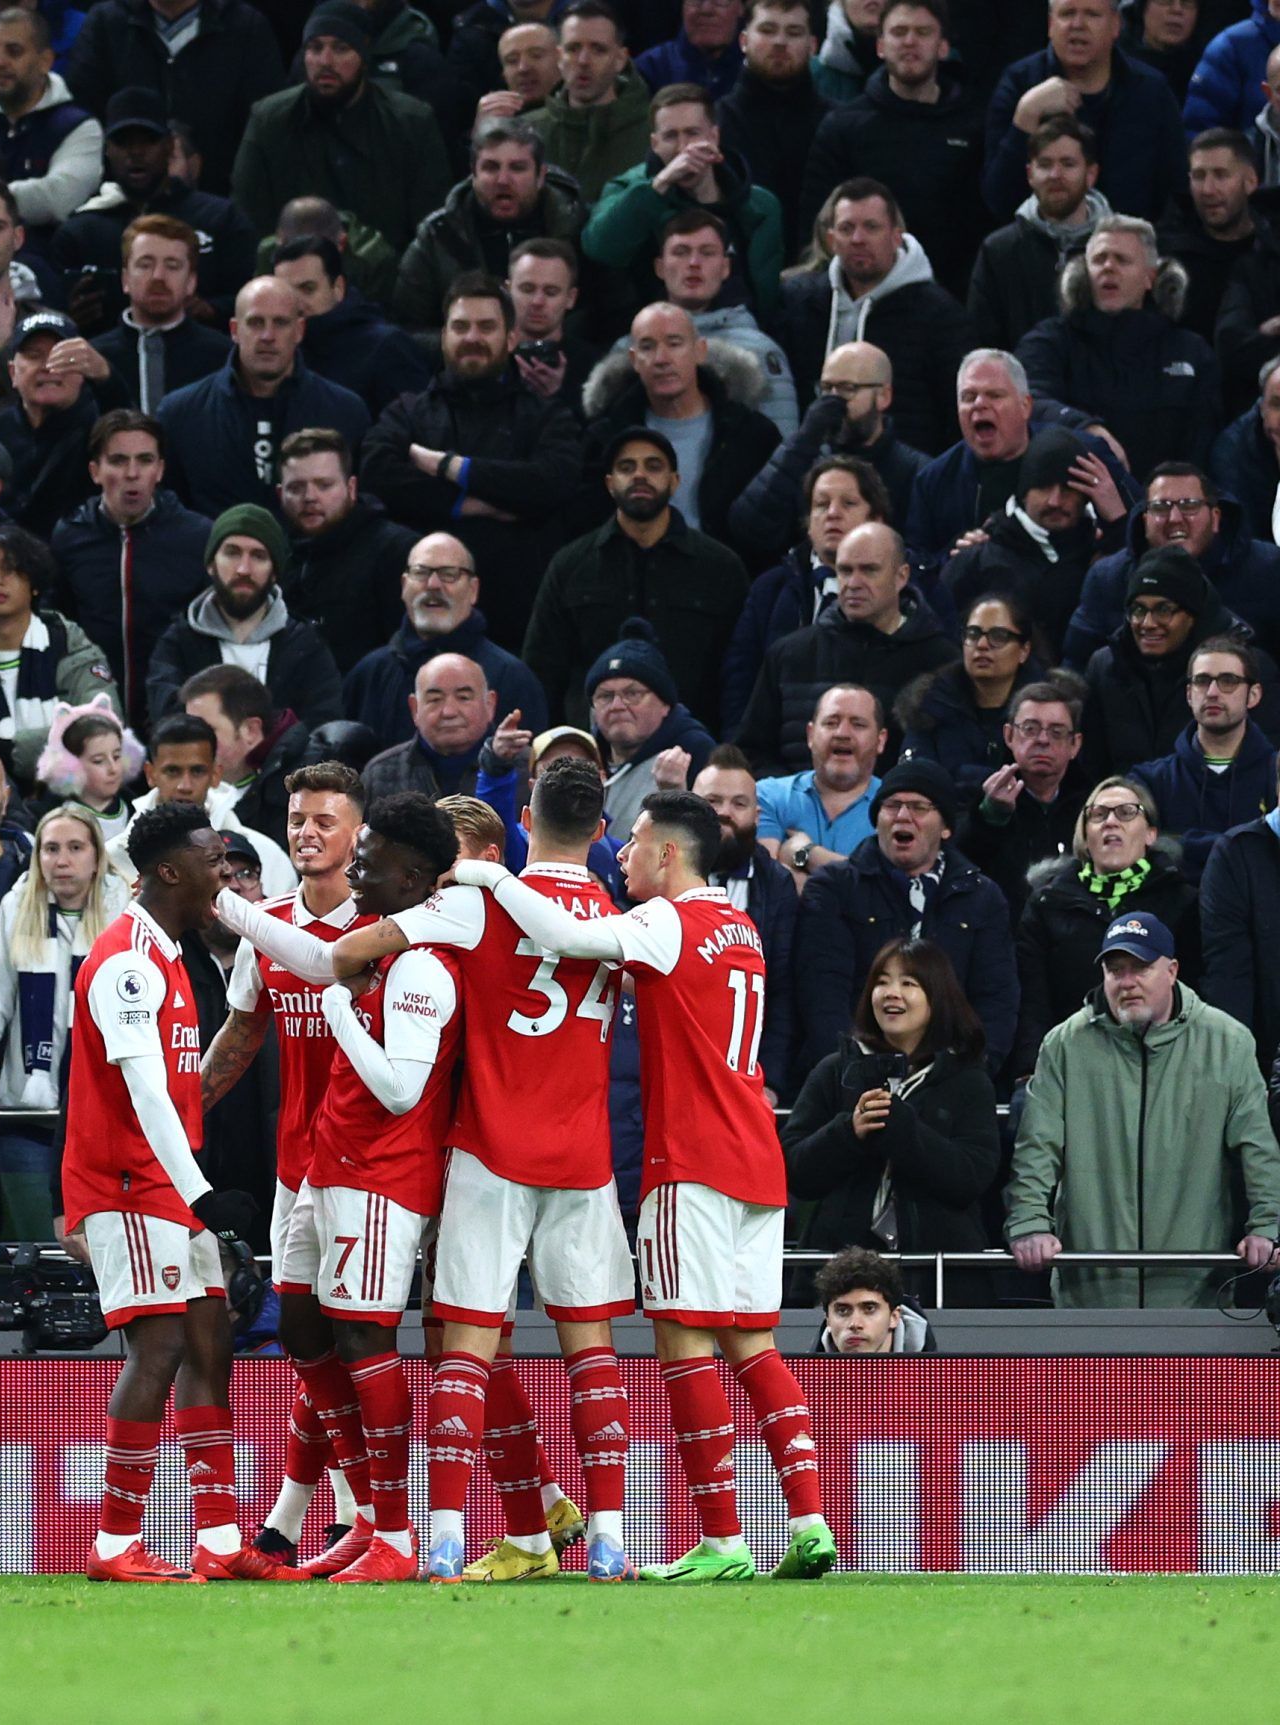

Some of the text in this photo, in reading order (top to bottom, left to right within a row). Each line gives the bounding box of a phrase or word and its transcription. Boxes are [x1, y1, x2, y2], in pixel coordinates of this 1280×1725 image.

[268, 985, 322, 1012] Emir
[403, 991, 431, 1005] VISIT
[507, 937, 616, 1043] 34
[392, 1001, 438, 1018] RWANDA
[285, 1016, 302, 1037] FLY
[728, 969, 765, 1076] 11
[334, 1236, 359, 1279] 7
[326, 1429, 342, 1439] FC
[430, 1428, 473, 1439] adidas
[587, 1433, 629, 1442] adidas
